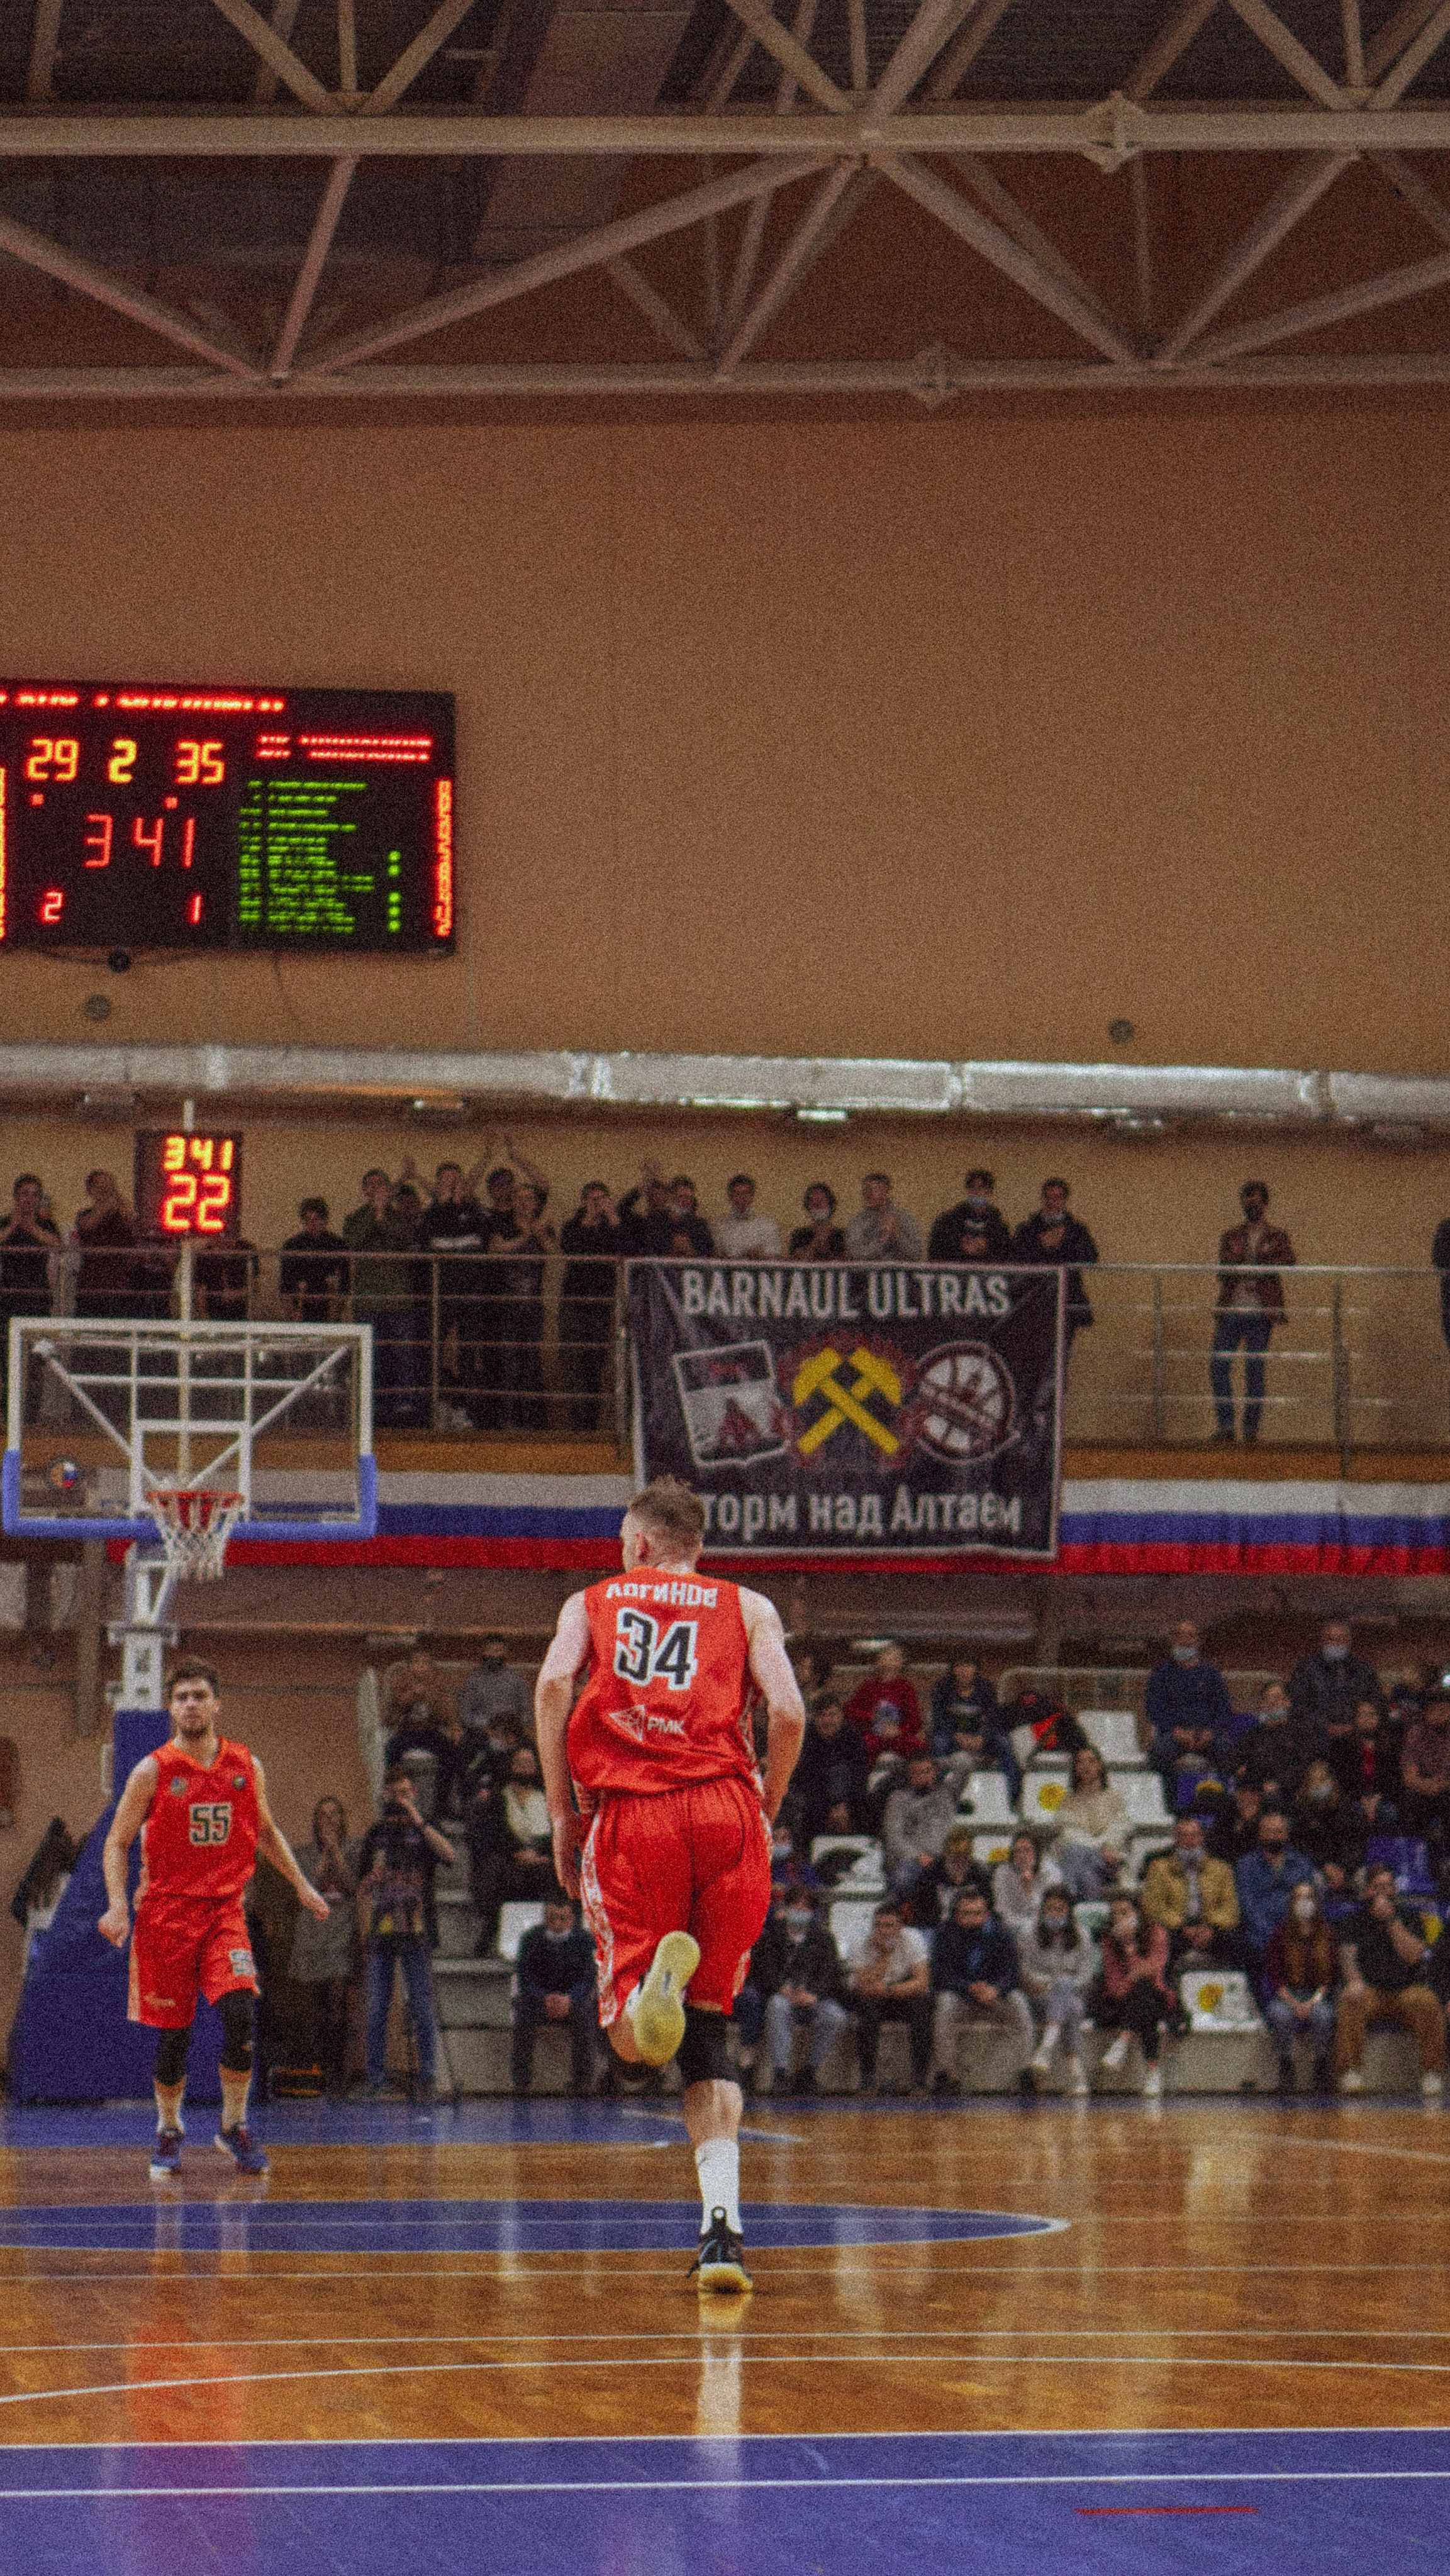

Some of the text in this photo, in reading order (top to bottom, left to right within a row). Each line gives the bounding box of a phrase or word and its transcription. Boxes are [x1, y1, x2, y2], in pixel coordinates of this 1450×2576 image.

[28, 738, 79, 780] 29
[108, 739, 137, 783] 2
[176, 741, 225, 784] 35
[44, 891, 63, 923] 2
[191, 894, 203, 924] 1
[163, 1174, 231, 1230] 22
[682, 1269, 1008, 1319] BARNAUL ULTRAS
[700, 1484, 1023, 1542] торм над Алтаем
[613, 1607, 698, 1690] 34
[189, 1802, 232, 1845] 55
